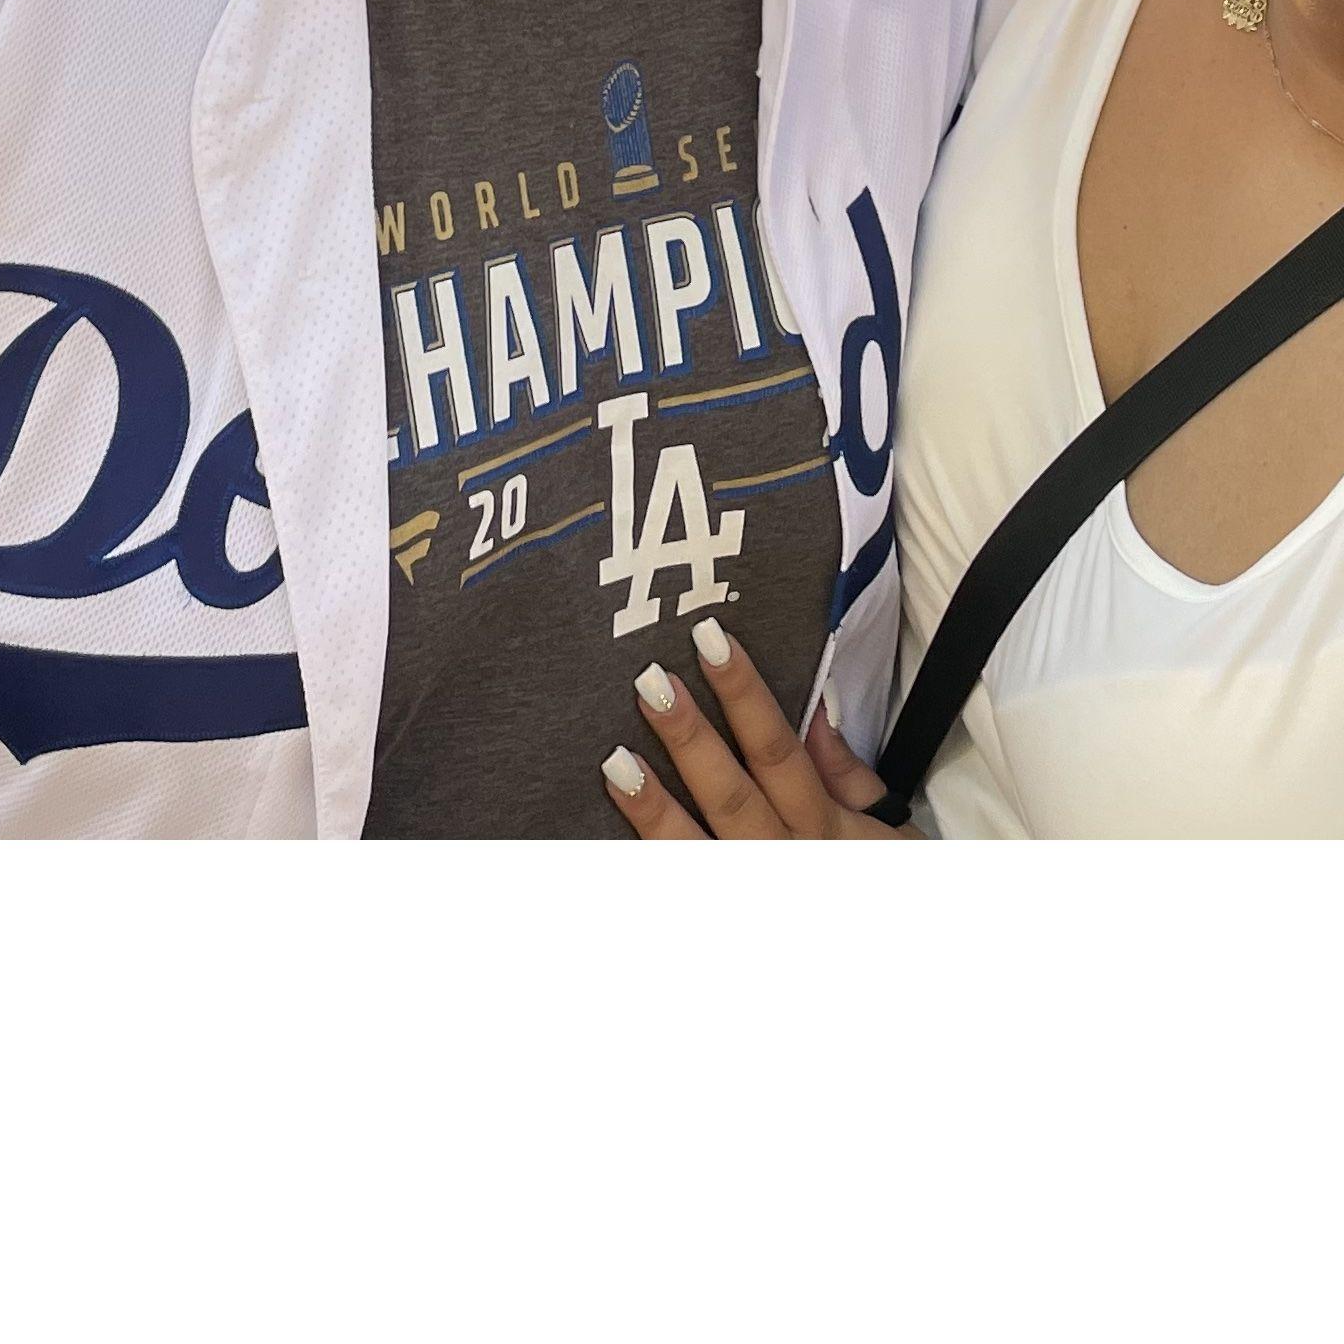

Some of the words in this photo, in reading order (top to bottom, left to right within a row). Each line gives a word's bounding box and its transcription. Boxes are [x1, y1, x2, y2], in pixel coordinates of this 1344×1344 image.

[375, 161, 581, 256] WORLD
[677, 121, 750, 183] SE
[388, 200, 802, 464] HAMPI
[468, 472, 528, 561] 20
[597, 391, 746, 639] LA
